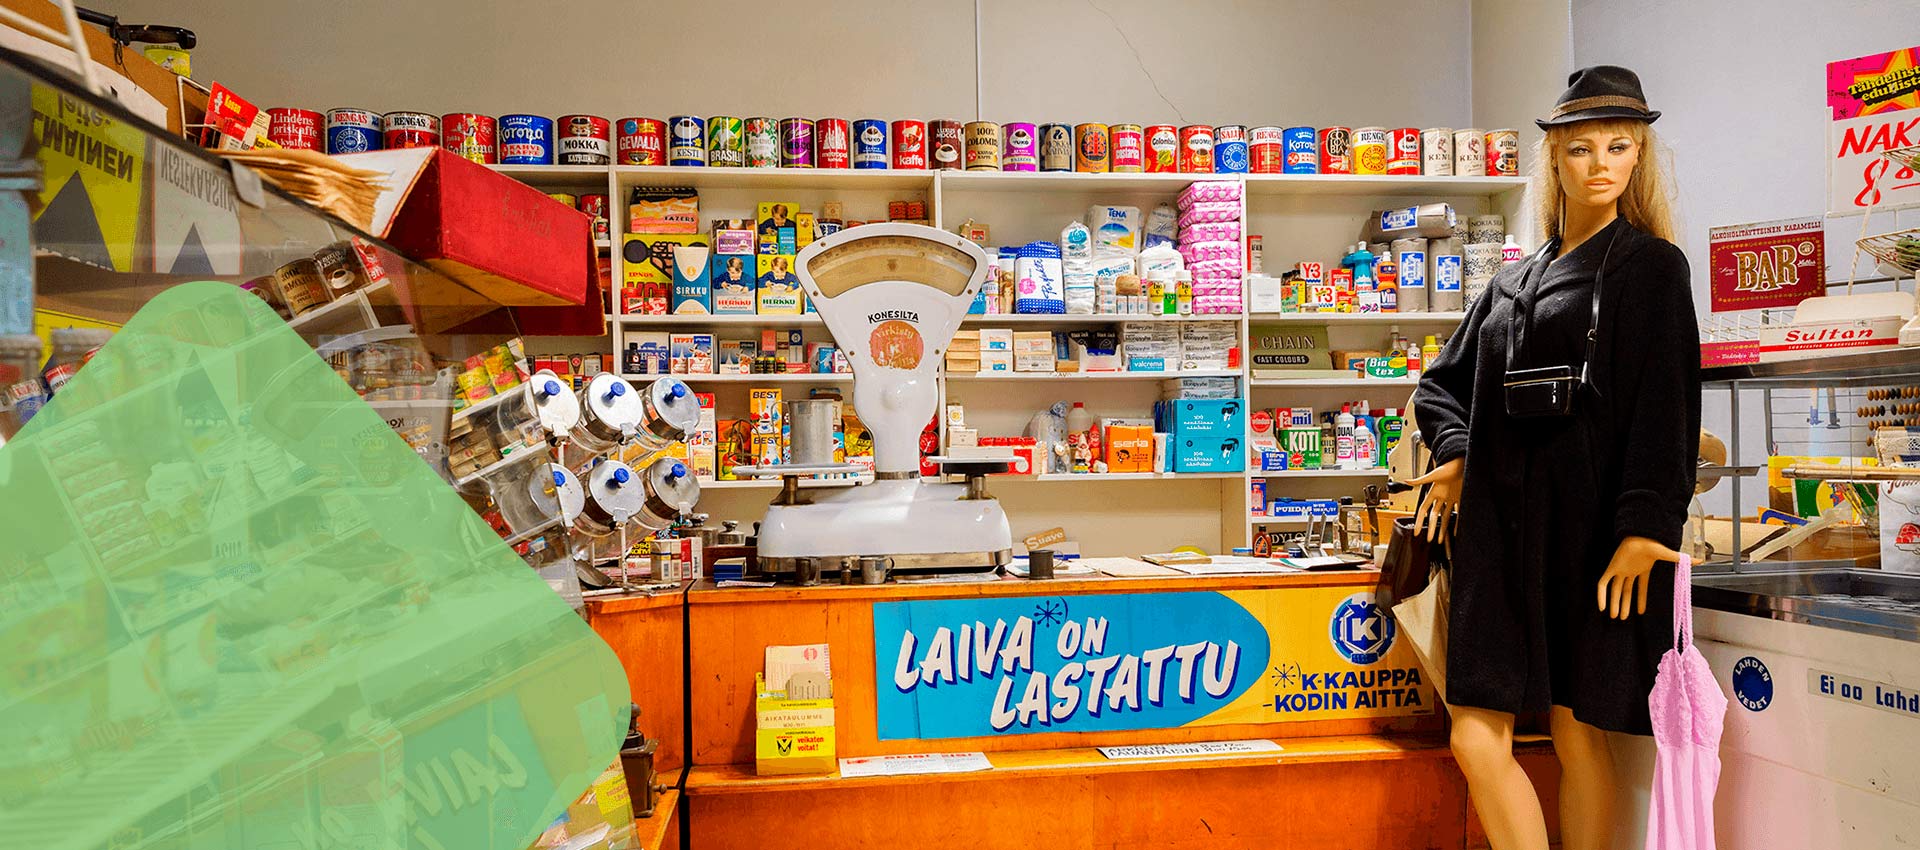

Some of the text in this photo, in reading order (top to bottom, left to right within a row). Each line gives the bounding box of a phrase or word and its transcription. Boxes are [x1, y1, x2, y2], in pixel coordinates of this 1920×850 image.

[1862, 77, 1920, 102] edullist
[273, 113, 315, 128] Lindens
[335, 112, 368, 125] RENGAS
[394, 115, 427, 128] RENGAS
[273, 124, 318, 139] priskaffe
[1837, 115, 1920, 158] NAK
[564, 140, 600, 151] MOKKA
[619, 136, 661, 152] GEVALIA
[899, 153, 924, 166] kaffe
[664, 215, 695, 223] FAZERS
[1107, 207, 1128, 219] TENA
[1732, 244, 1799, 293] BAR
[675, 286, 708, 296] SIRKKU
[867, 310, 920, 324] KONESILTA
[1260, 334, 1316, 350] CHAIN
[1784, 327, 1873, 343] Sultan
[1257, 356, 1306, 364] FAST COLOURS
[752, 391, 780, 399] BEST
[753, 437, 780, 445] BEST
[1113, 438, 1149, 448] serla
[1288, 431, 1319, 452] KOTI
[1026, 531, 1063, 549] Suave
[894, 614, 1109, 694] LAIVA ON
[1734, 658, 1770, 683] LAHDEN
[989, 640, 1243, 732] LASTATTU
[1301, 668, 1422, 691] K-KAUPPA
[1820, 674, 1835, 695] Ei
[1354, 688, 1423, 709] AITTA
[1736, 690, 1768, 710] VEDET
